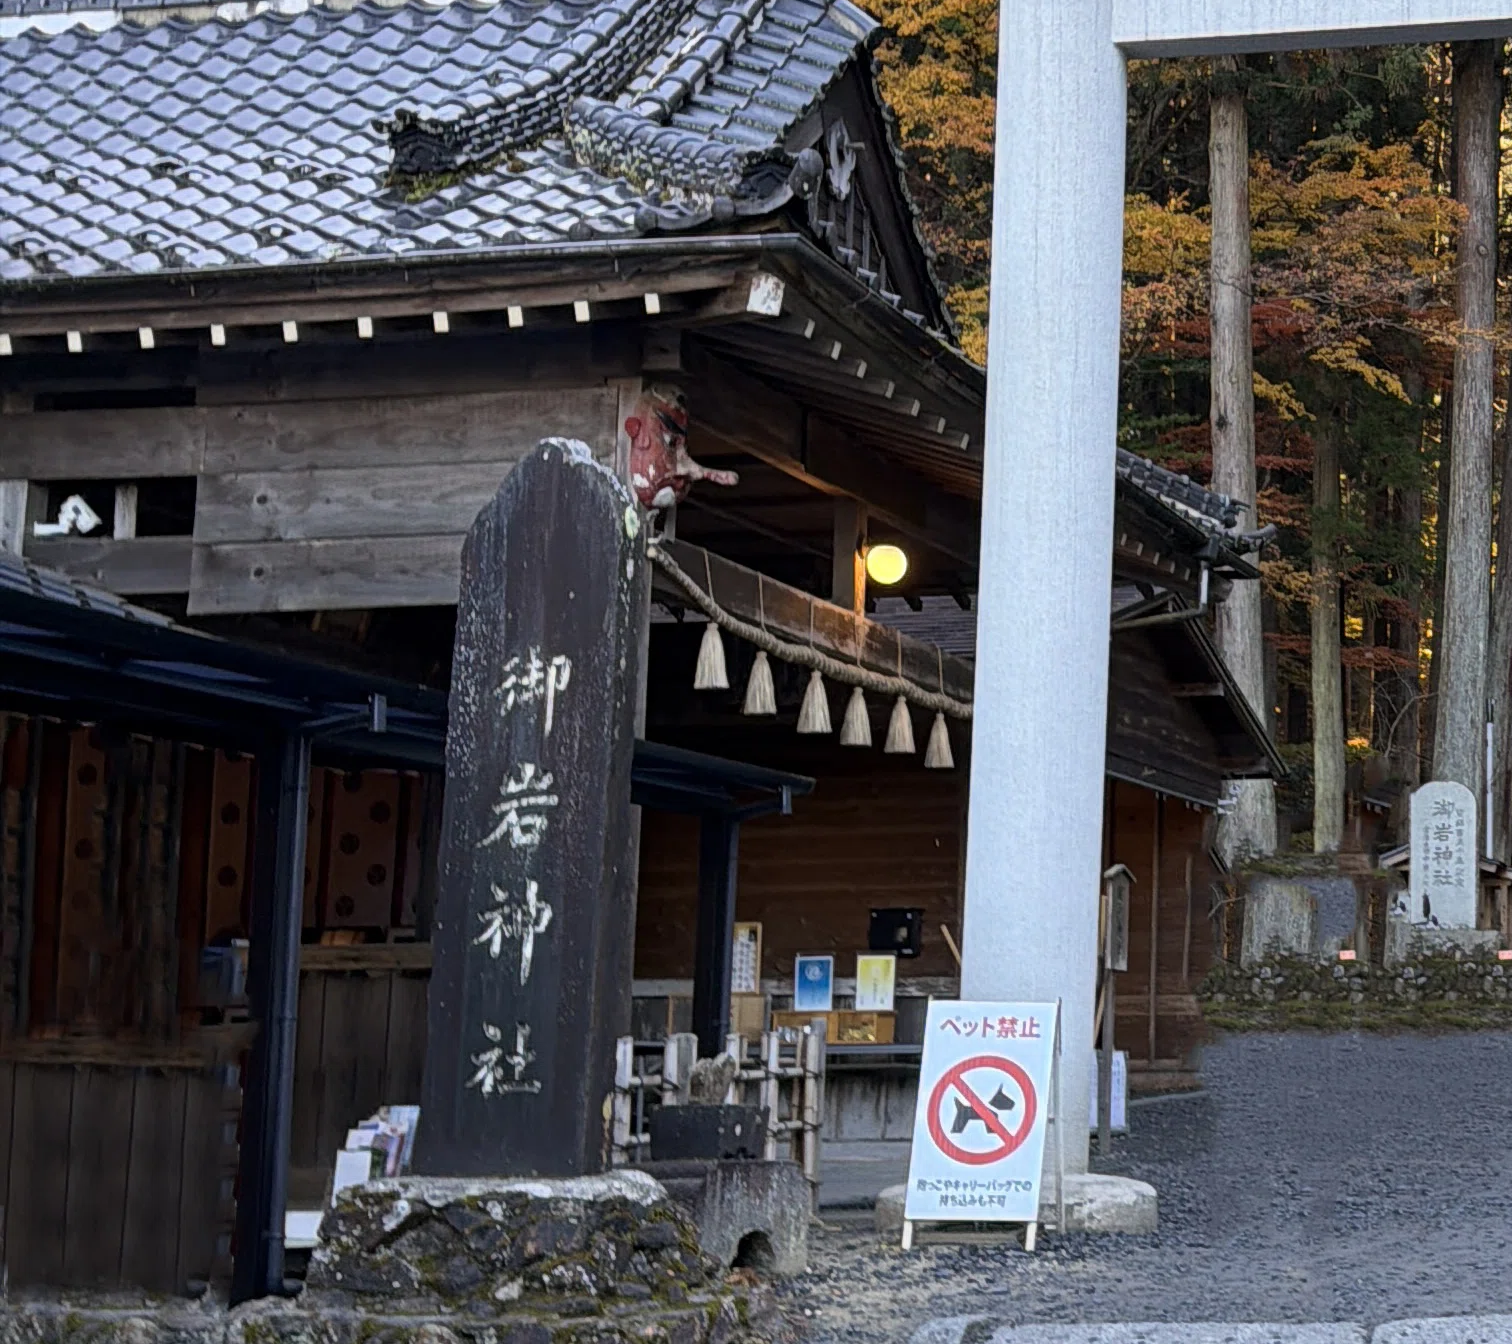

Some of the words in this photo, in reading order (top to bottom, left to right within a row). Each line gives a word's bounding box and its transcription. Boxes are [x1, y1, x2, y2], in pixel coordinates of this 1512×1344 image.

[465, 645, 572, 1099] 御岩神社
[1432, 799, 1455, 886] 御岩神社
[940, 1016, 1041, 1038] ペット禁止
